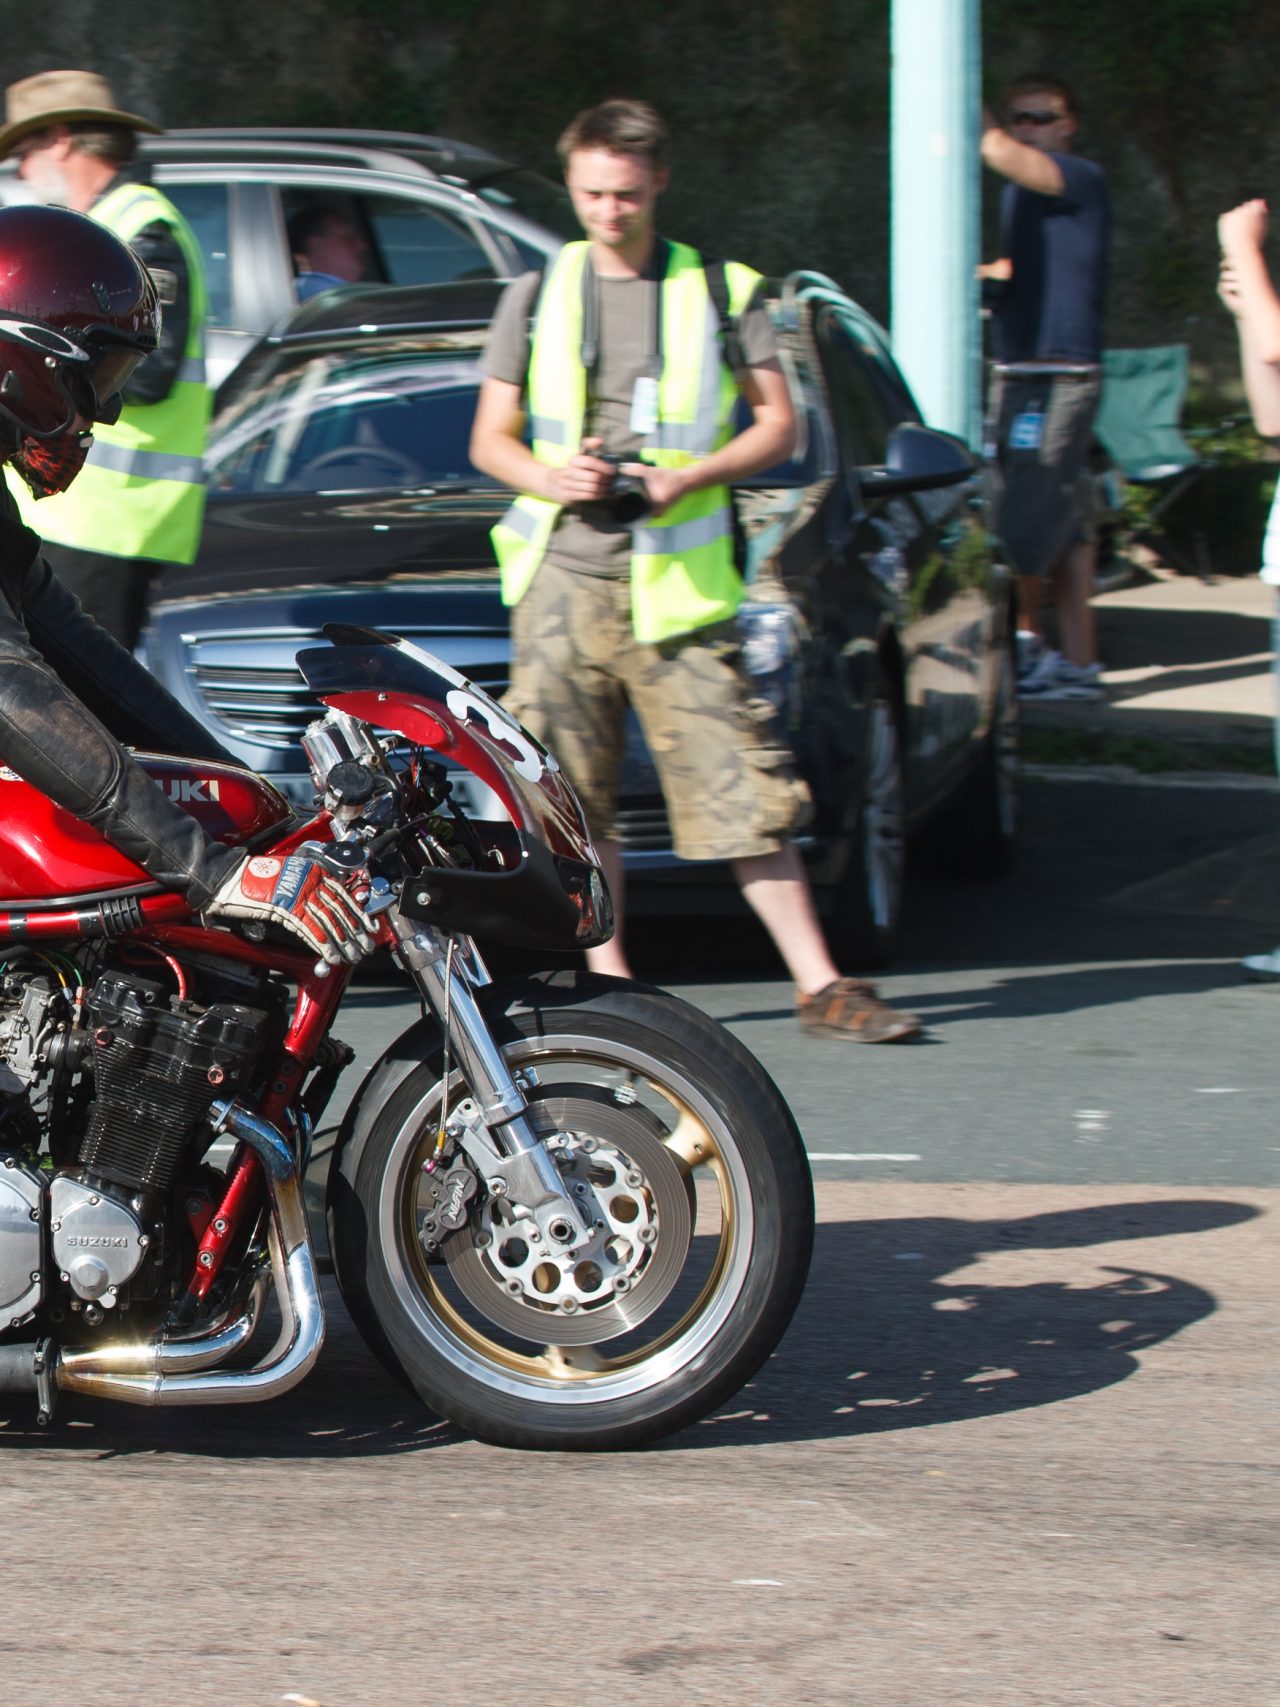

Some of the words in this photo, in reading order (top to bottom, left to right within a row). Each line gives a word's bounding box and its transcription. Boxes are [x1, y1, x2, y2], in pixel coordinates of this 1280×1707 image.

[154, 779, 220, 802] UKI
[448, 1178, 465, 1222] NISSIN
[67, 1235, 128, 1248] SUZUKI
